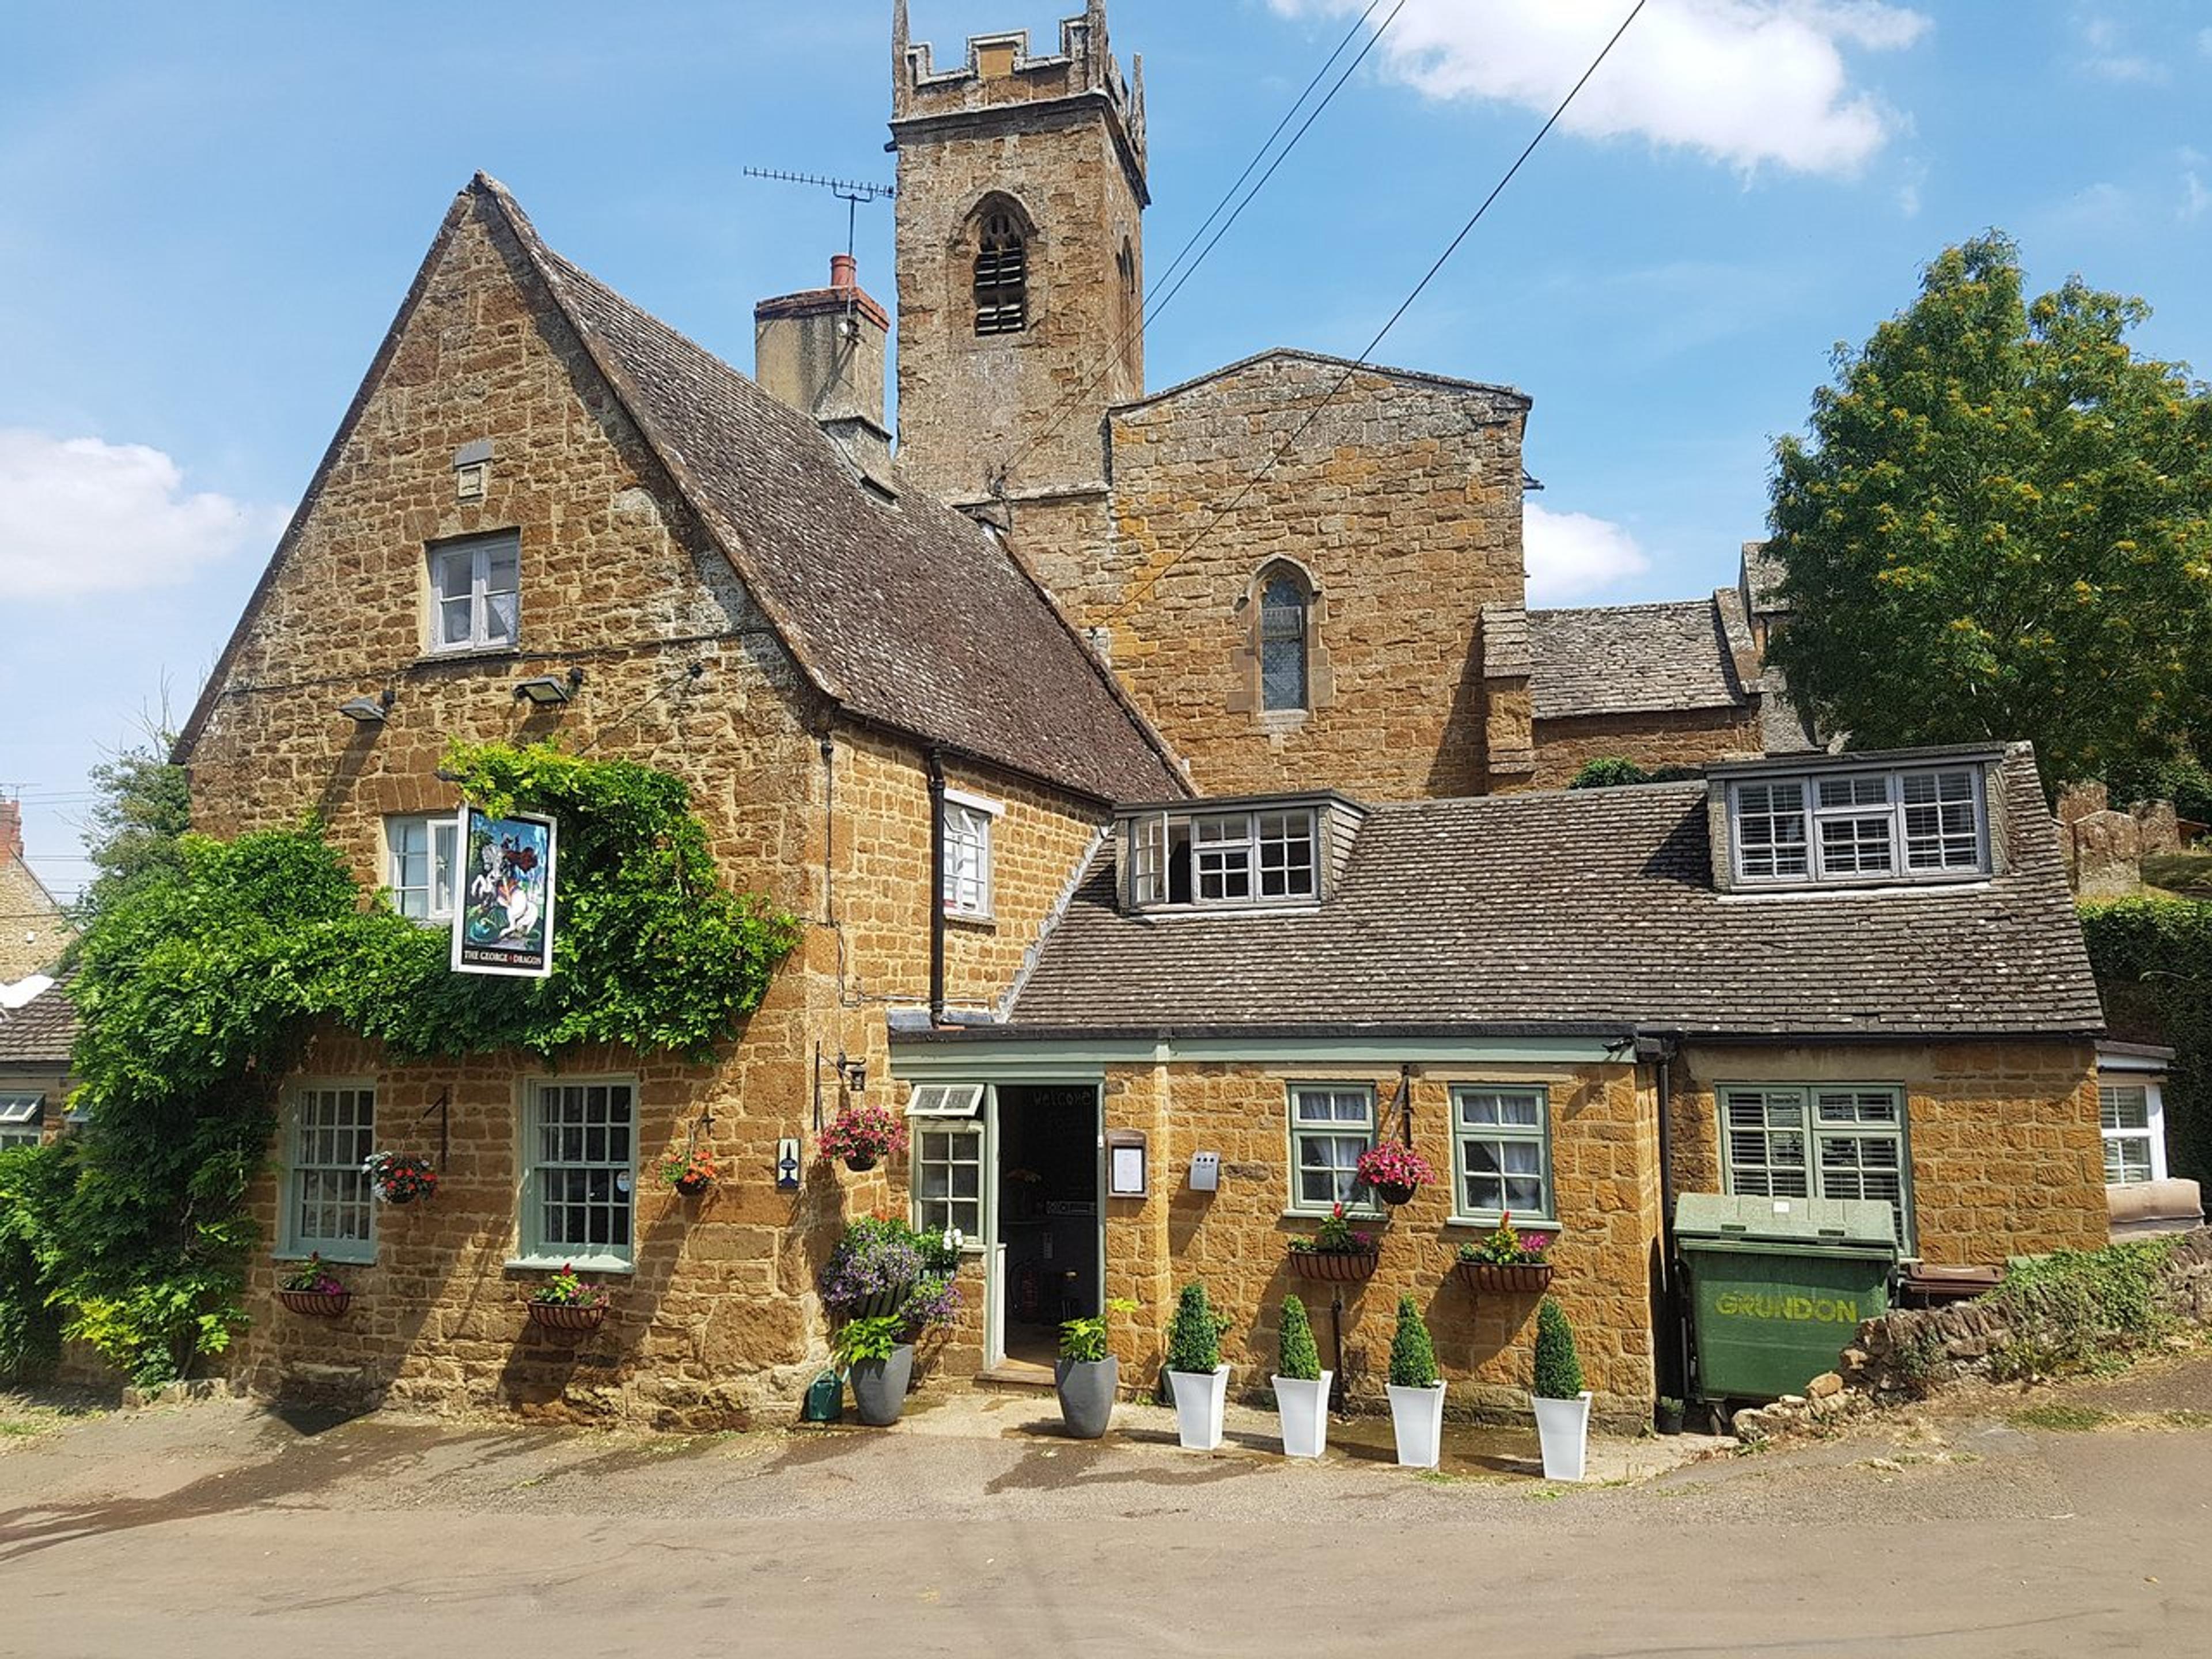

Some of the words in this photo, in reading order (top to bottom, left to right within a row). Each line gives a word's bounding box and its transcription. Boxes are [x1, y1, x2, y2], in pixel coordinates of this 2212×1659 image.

[464, 950, 479, 960] THE
[480, 952, 507, 962] GEORGE
[513, 954, 541, 965] DRAGON
[1716, 1294, 1857, 1323] GRUNDON
